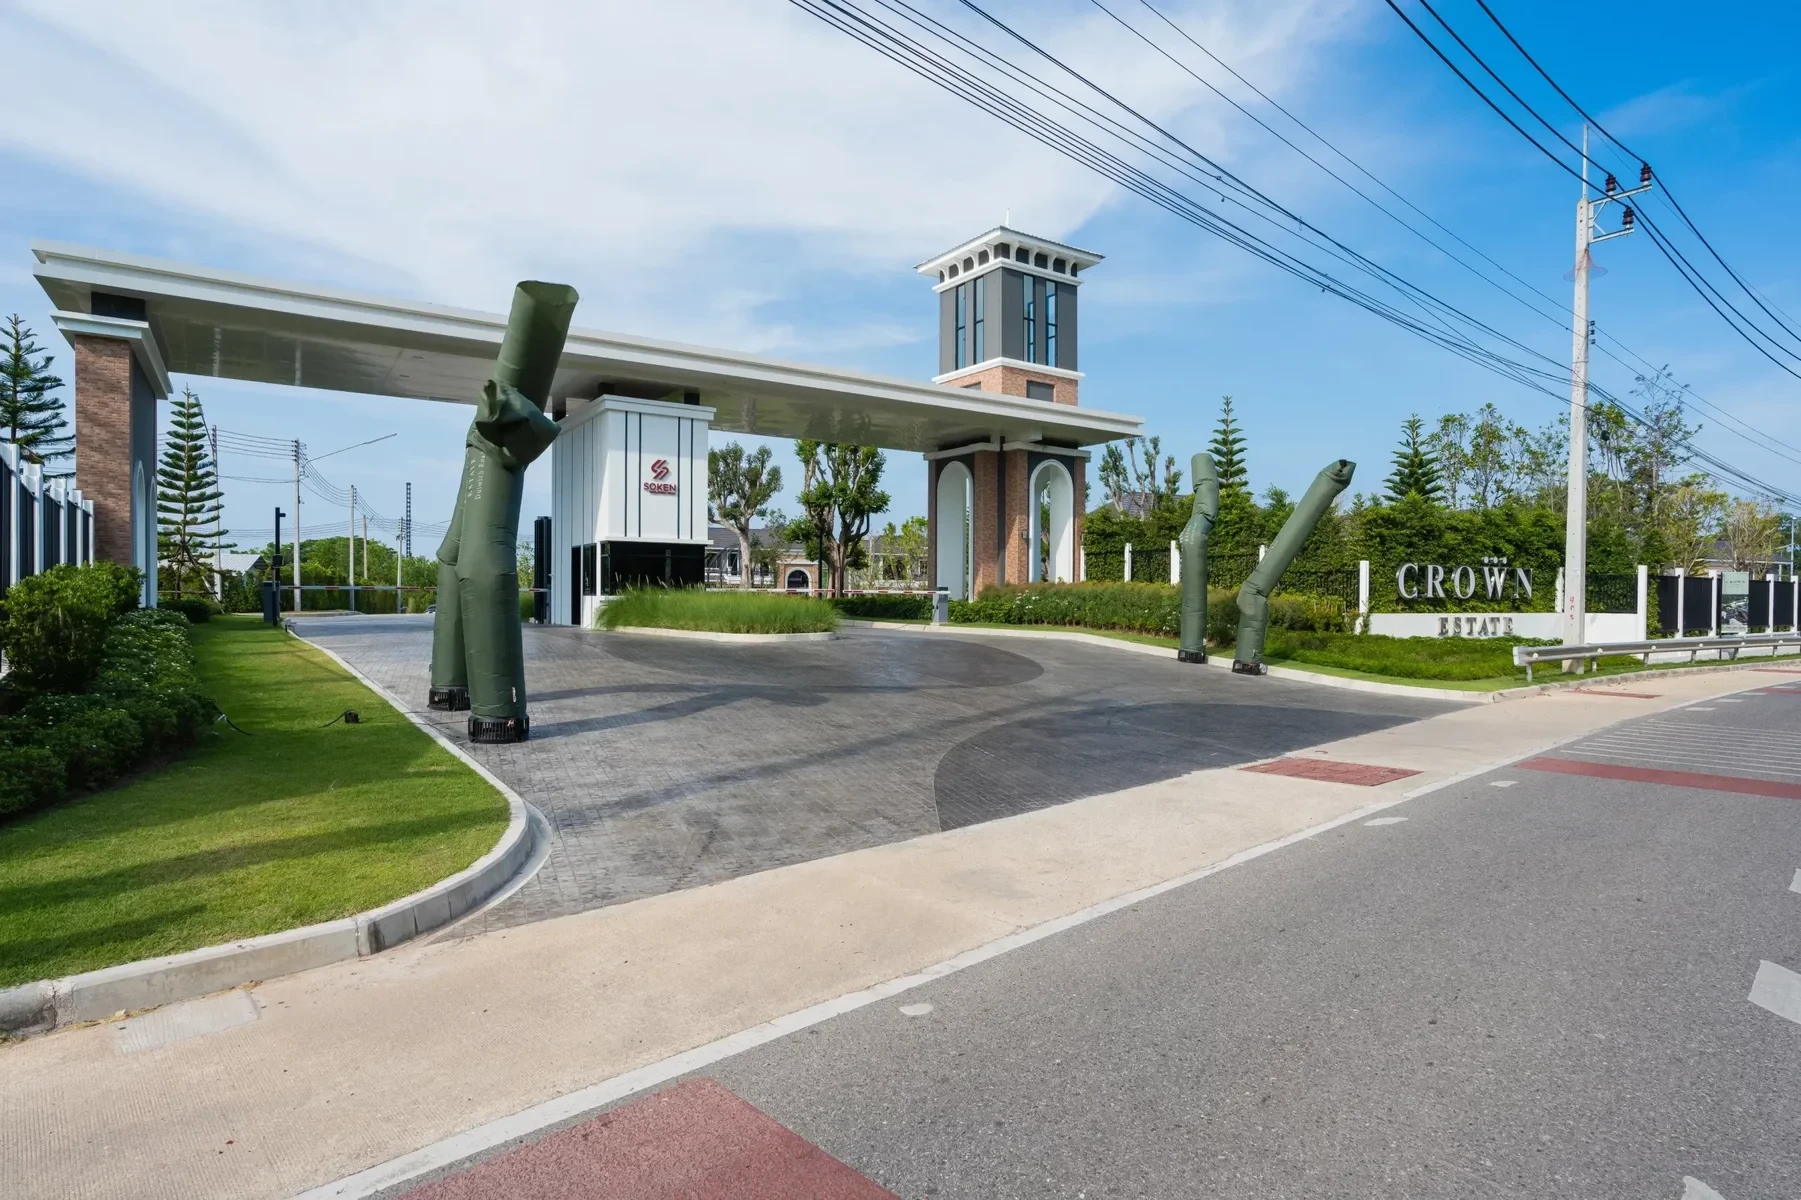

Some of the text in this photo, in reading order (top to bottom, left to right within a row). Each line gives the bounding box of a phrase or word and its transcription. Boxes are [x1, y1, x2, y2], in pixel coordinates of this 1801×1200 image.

[474, 470, 484, 500] Dulwich
[643, 482, 677, 492] SOKEN
[1396, 562, 1533, 600] CROWN
[1438, 617, 1514, 636] ESTATE
